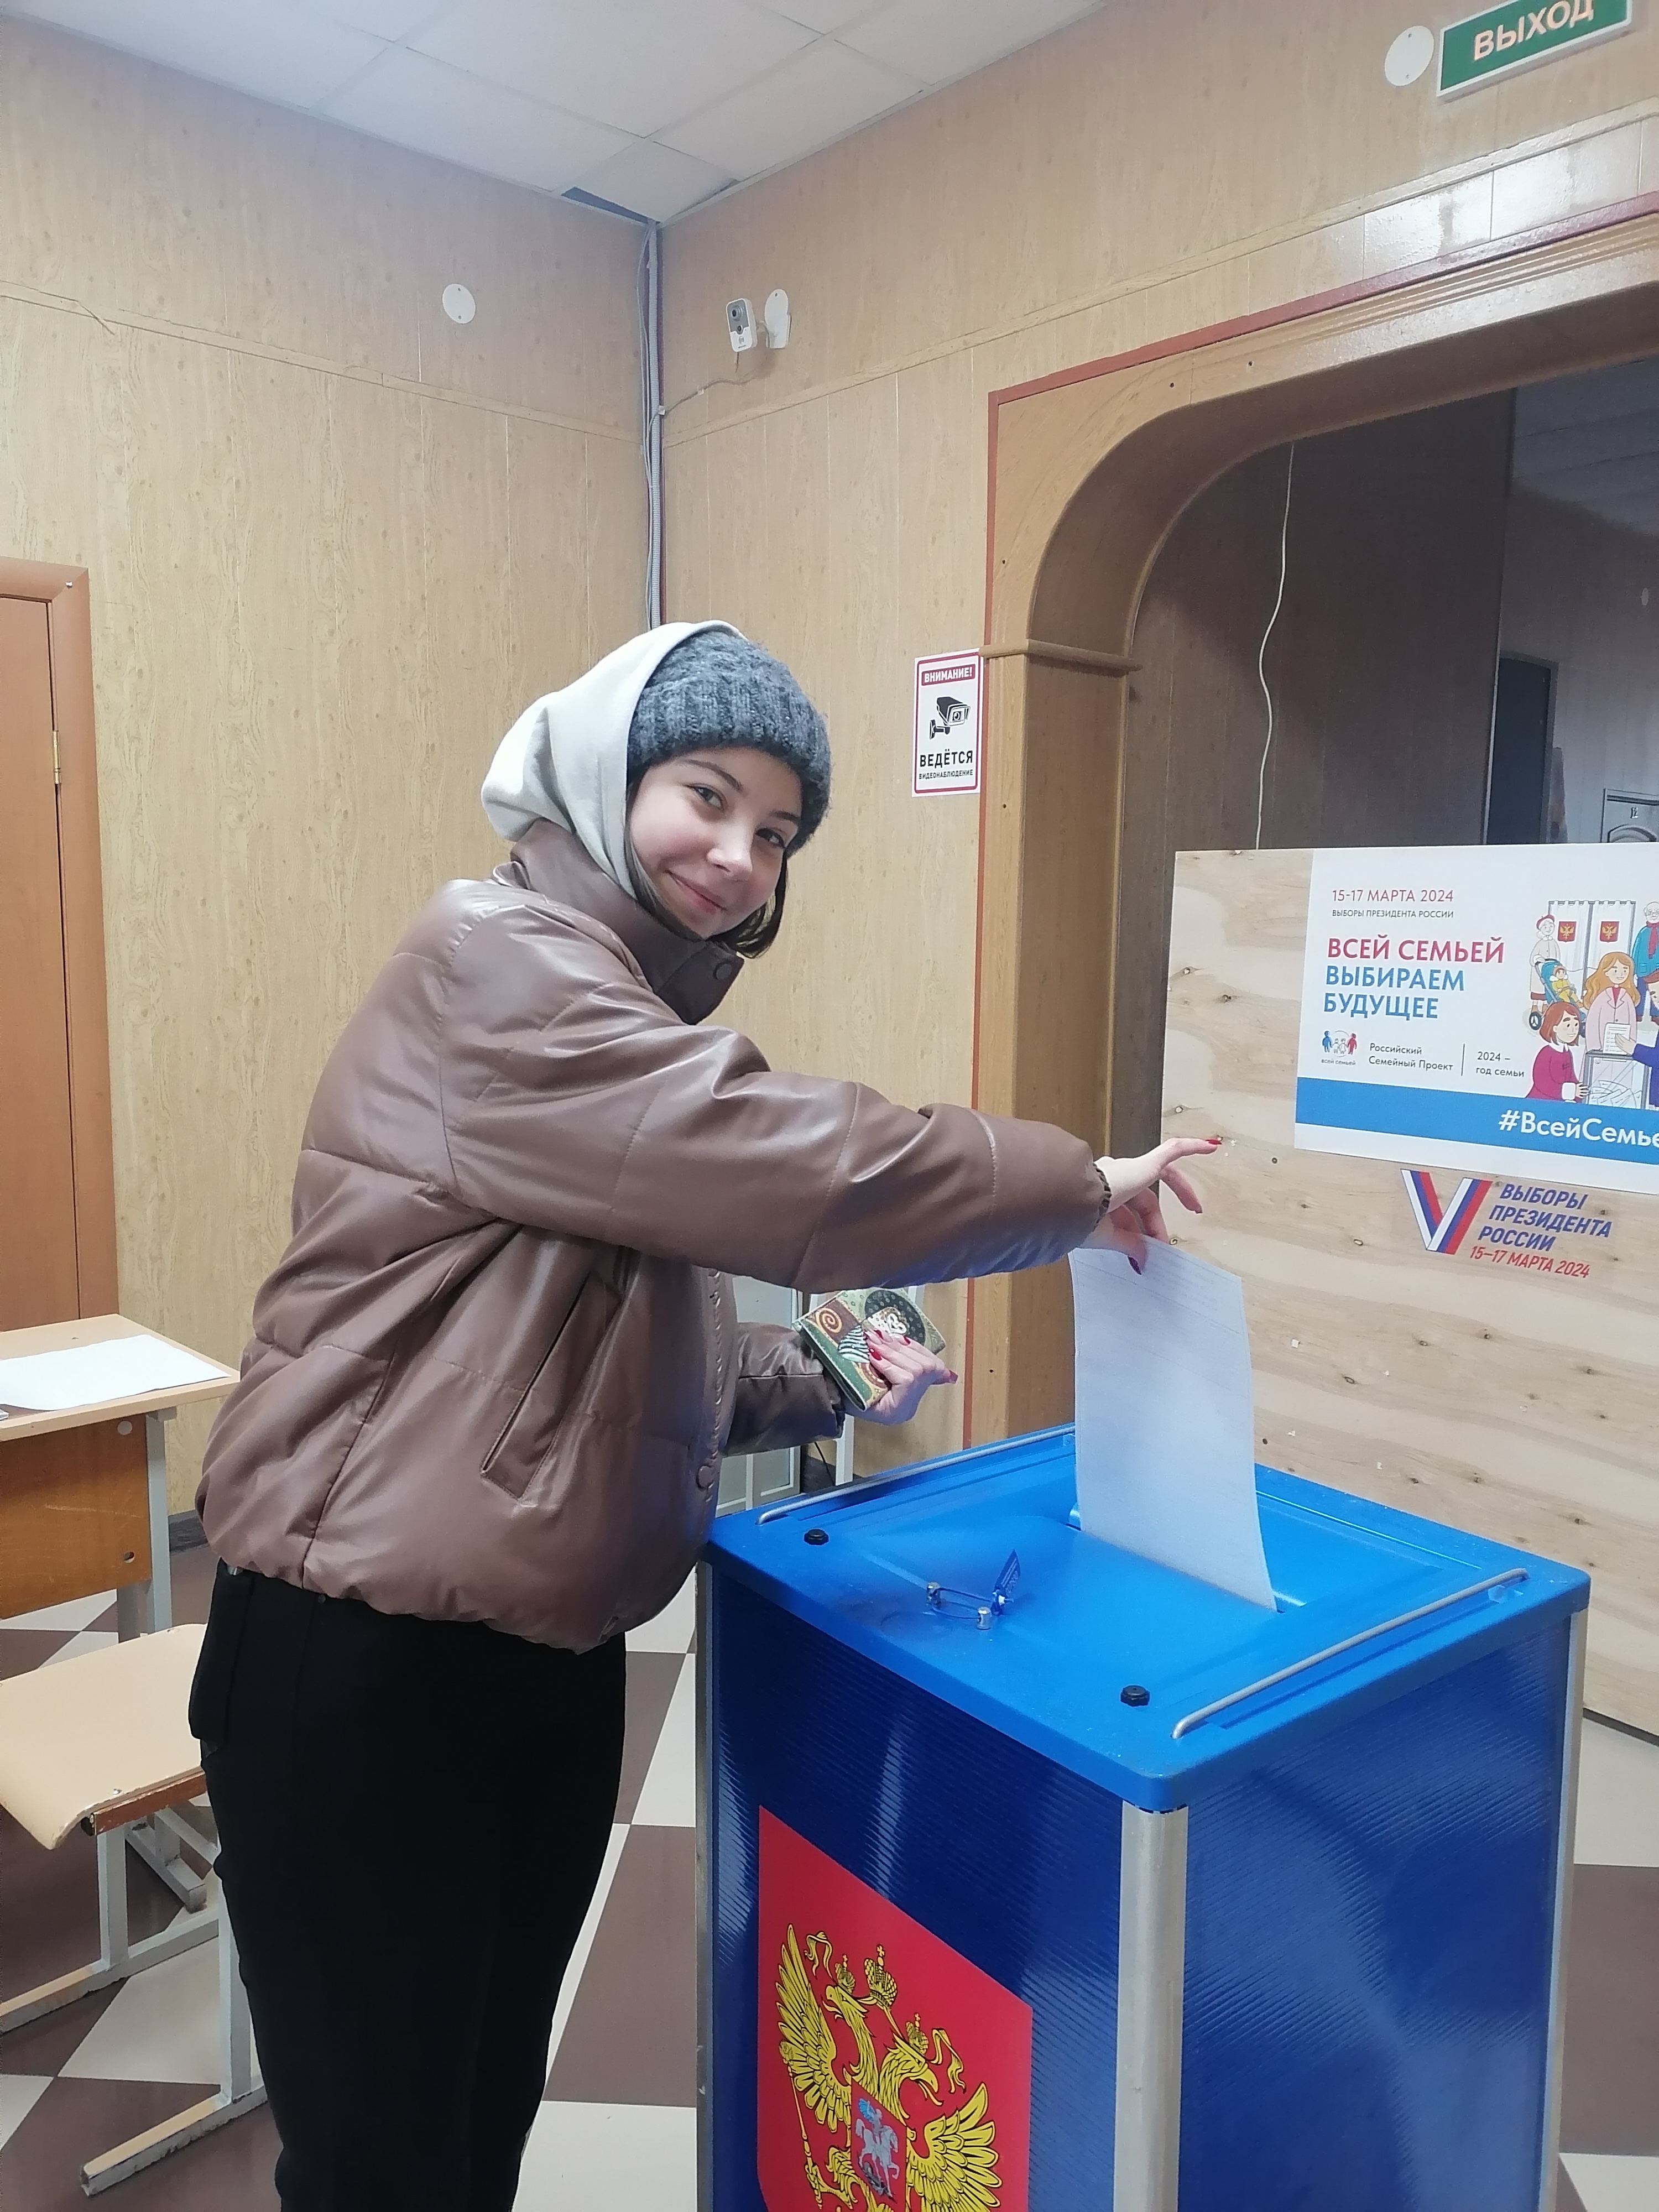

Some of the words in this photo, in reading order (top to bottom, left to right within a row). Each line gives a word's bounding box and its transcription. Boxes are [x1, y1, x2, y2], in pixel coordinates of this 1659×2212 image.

[1474, 0, 1594, 61] ВЫХОД
[924, 666, 973, 683] ВНИМАНИЕ!
[920, 749, 973, 769] ВЕДЁТСЯ
[919, 769, 973, 780] ВИДЕОНАБЛЮДЕНИЕ
[1332, 889, 1363, 902] 15-17
[1367, 890, 1415, 902] МАРТА
[1420, 890, 1454, 902] 2024
[1366, 910, 1416, 919] ПРЕЗИДЕНТА
[1328, 934, 1390, 959] ВСЕЙ
[1398, 936, 1505, 963] СЕМЬЕЙ
[1326, 966, 1464, 991] ВЫБИРАЕМ
[1324, 993, 1439, 1021] БУДУЩЕЕ
[1370, 1042, 1422, 1055] Российский
[1477, 1051, 1501, 1062] 2024
[1369, 1056, 1416, 1068] Семейный
[1419, 1060, 1453, 1071] Проект
[1475, 1066, 1492, 1076] год
[1494, 1069, 1525, 1078] семьи
[1500, 1183, 1588, 1210] ВЫБОРЫ
[1489, 1204, 1612, 1238] ПРЕЗИДЕНТА
[1478, 1226, 1556, 1251] РОССИИ
[1507, 1252, 1554, 1272] МАРТА
[1554, 1260, 1590, 1278] 2024
